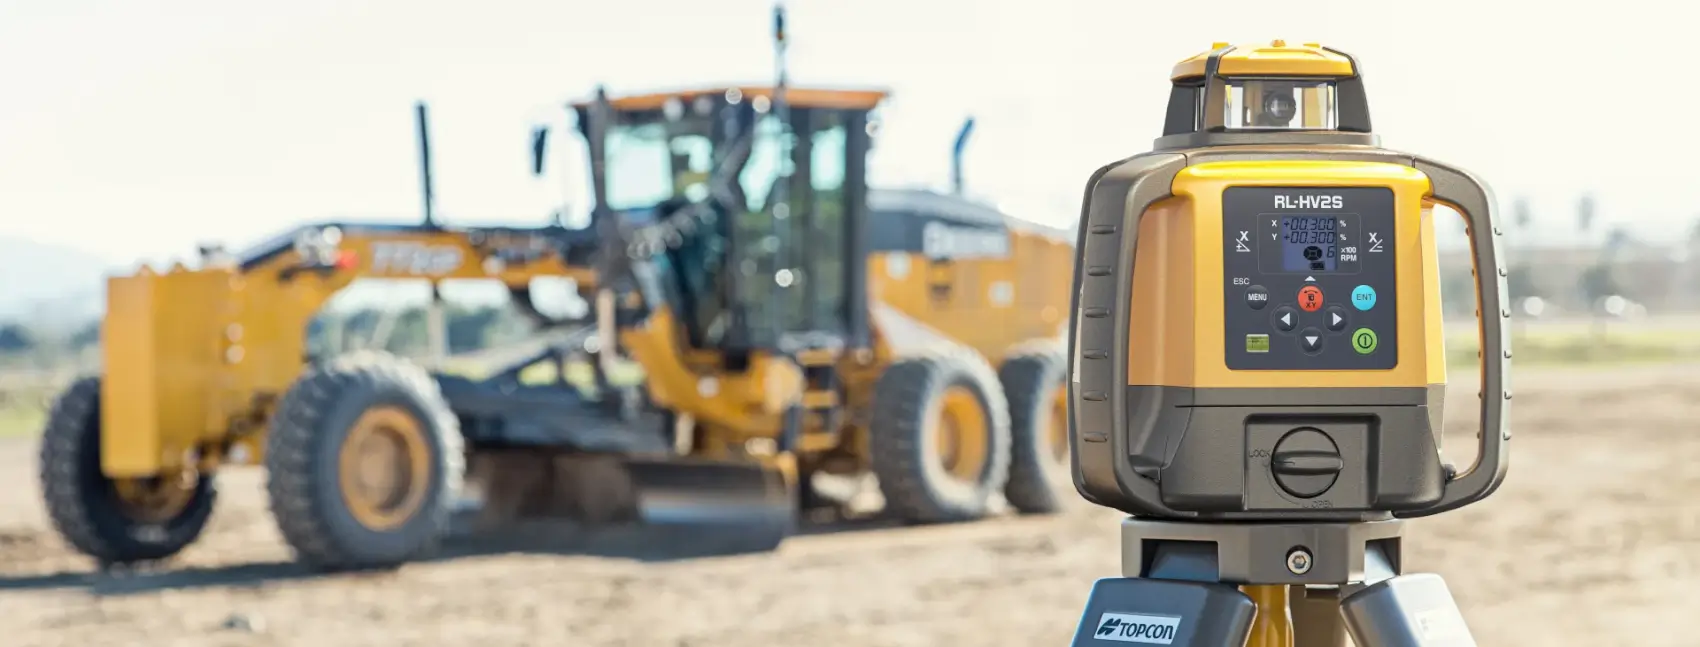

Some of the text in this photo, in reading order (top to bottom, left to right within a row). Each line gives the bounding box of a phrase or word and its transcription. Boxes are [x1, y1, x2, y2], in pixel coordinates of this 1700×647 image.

[1274, 195, 1343, 209] RL-HV2S
[1341, 254, 1357, 262] RPM
[1248, 293, 1267, 301] MENU
[1356, 293, 1373, 301] ENT
[1249, 449, 1271, 458] LOCK
[1311, 500, 1334, 509] OPEN
[1119, 622, 1174, 640] TOPCON
